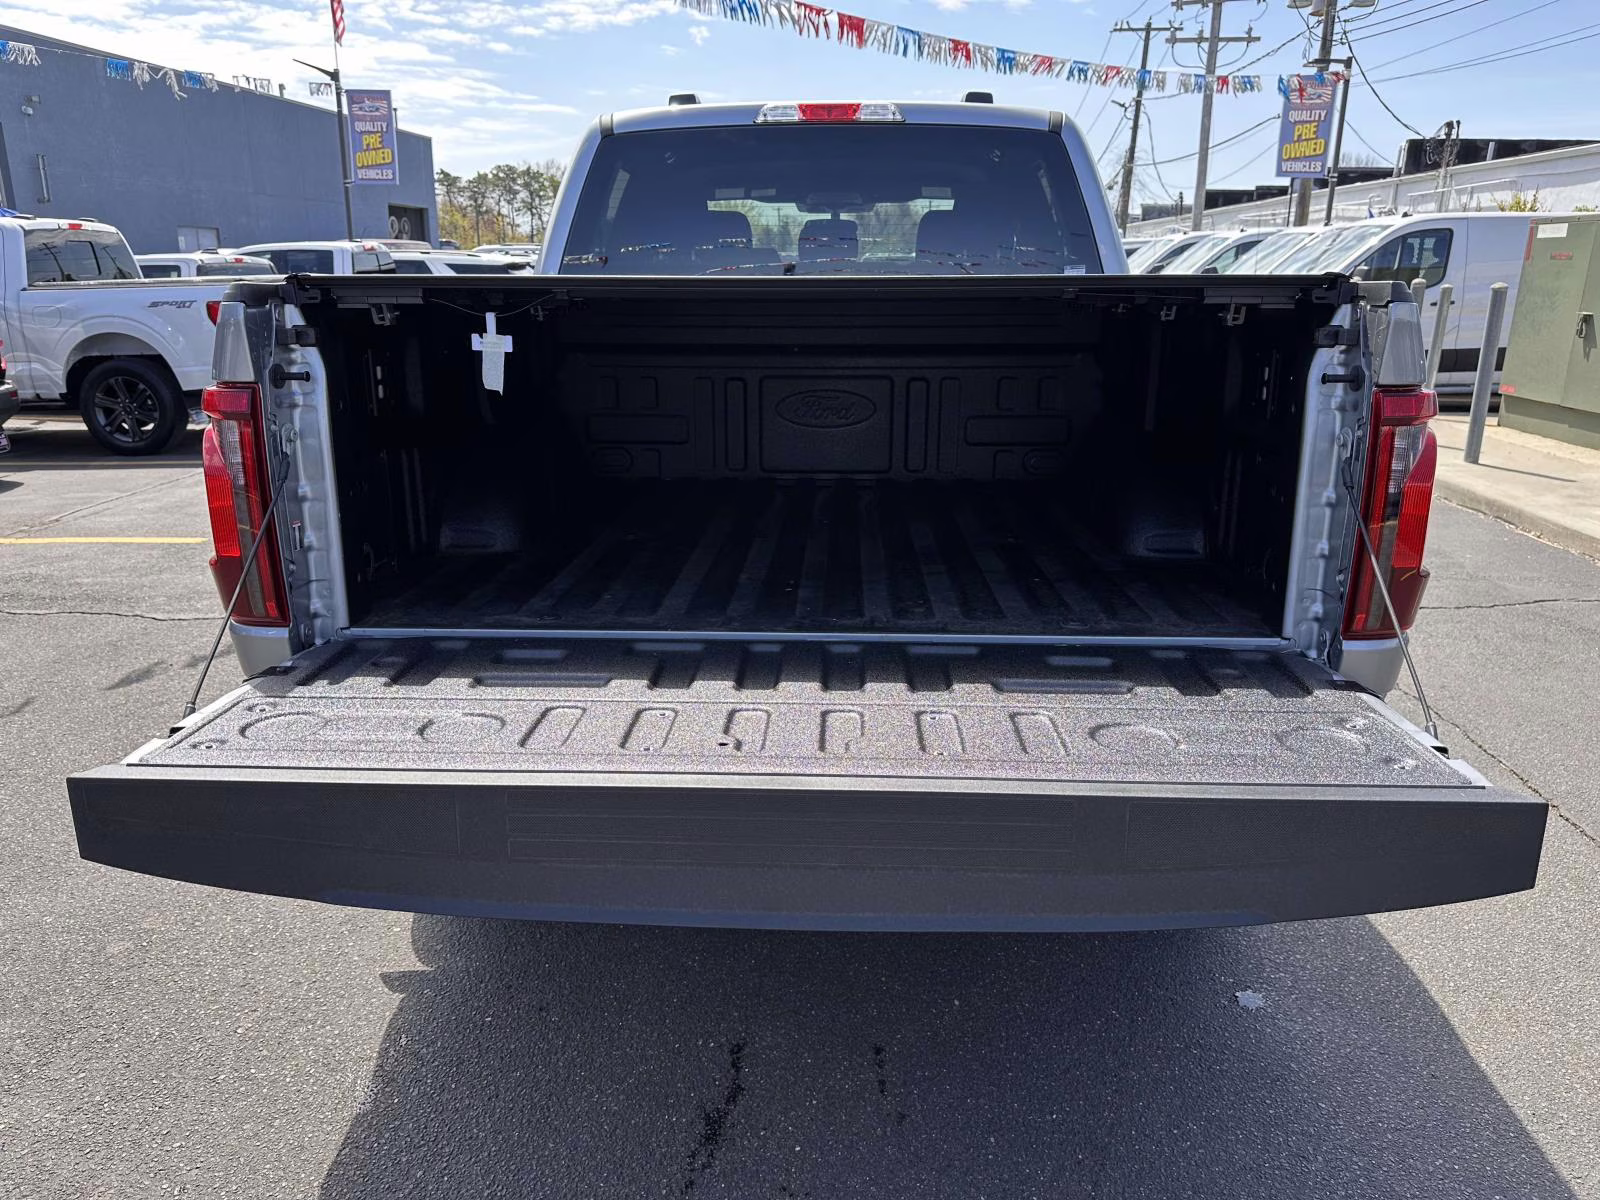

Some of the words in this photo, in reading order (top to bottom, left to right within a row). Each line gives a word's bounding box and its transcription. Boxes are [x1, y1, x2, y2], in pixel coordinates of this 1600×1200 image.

[1289, 110, 1327, 122] QUALITY
[355, 121, 387, 132] QUALITY
[1294, 122, 1318, 140] PRE
[363, 133, 382, 149] PRE
[1283, 139, 1325, 159] OWNED
[356, 149, 392, 167] OWNED
[357, 169, 393, 179] VEHICLES
[1281, 161, 1322, 172] VEHICLES
[788, 394, 857, 421] Ford
